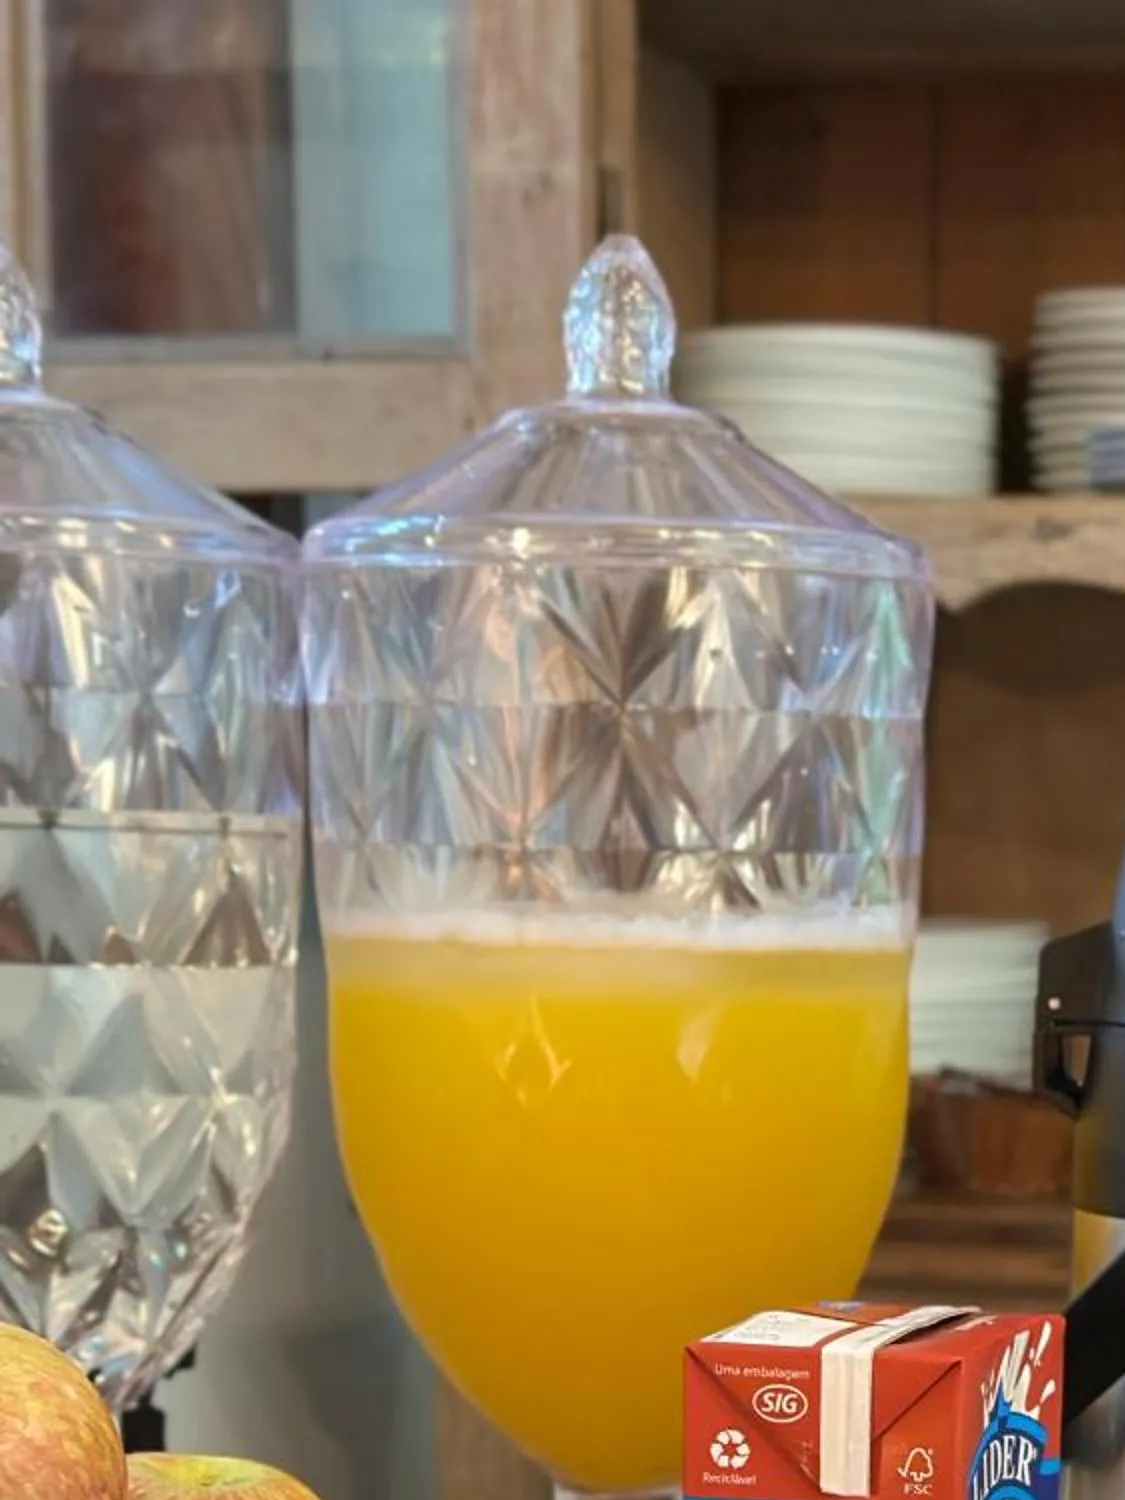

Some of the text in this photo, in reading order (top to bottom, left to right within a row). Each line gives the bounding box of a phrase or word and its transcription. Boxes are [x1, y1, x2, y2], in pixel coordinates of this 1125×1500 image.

[715, 1364, 810, 1381] Uma embalagem
[761, 1392, 798, 1413] SIG
